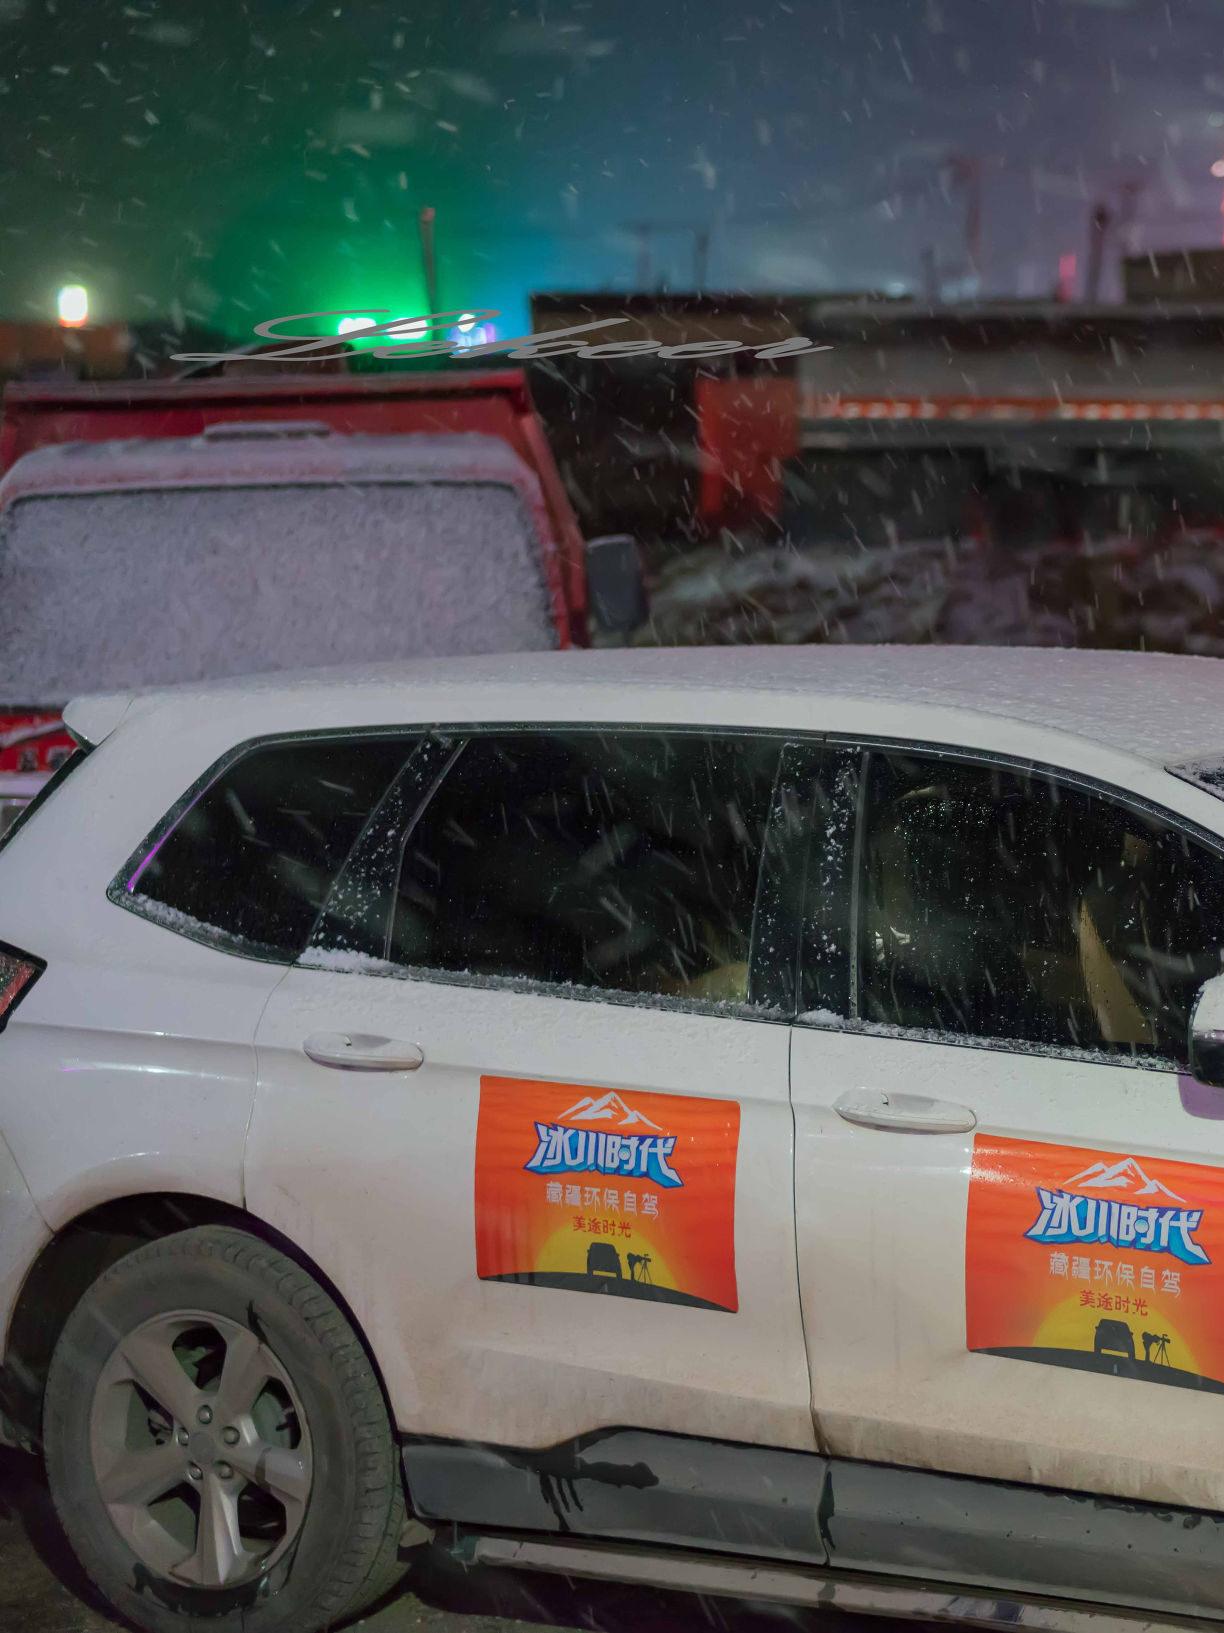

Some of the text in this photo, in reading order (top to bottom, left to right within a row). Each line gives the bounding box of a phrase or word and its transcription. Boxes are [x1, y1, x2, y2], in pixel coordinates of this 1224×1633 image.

[523, 1121, 684, 1188] 冰川时代
[546, 1181, 659, 1220] 藏疆环保自驾
[573, 1216, 632, 1238] 美途时光
[1023, 1187, 1212, 1265] 冰川时代
[1049, 1252, 1182, 1299] 藏疆环保自驾
[1079, 1290, 1149, 1317] 美途时光
